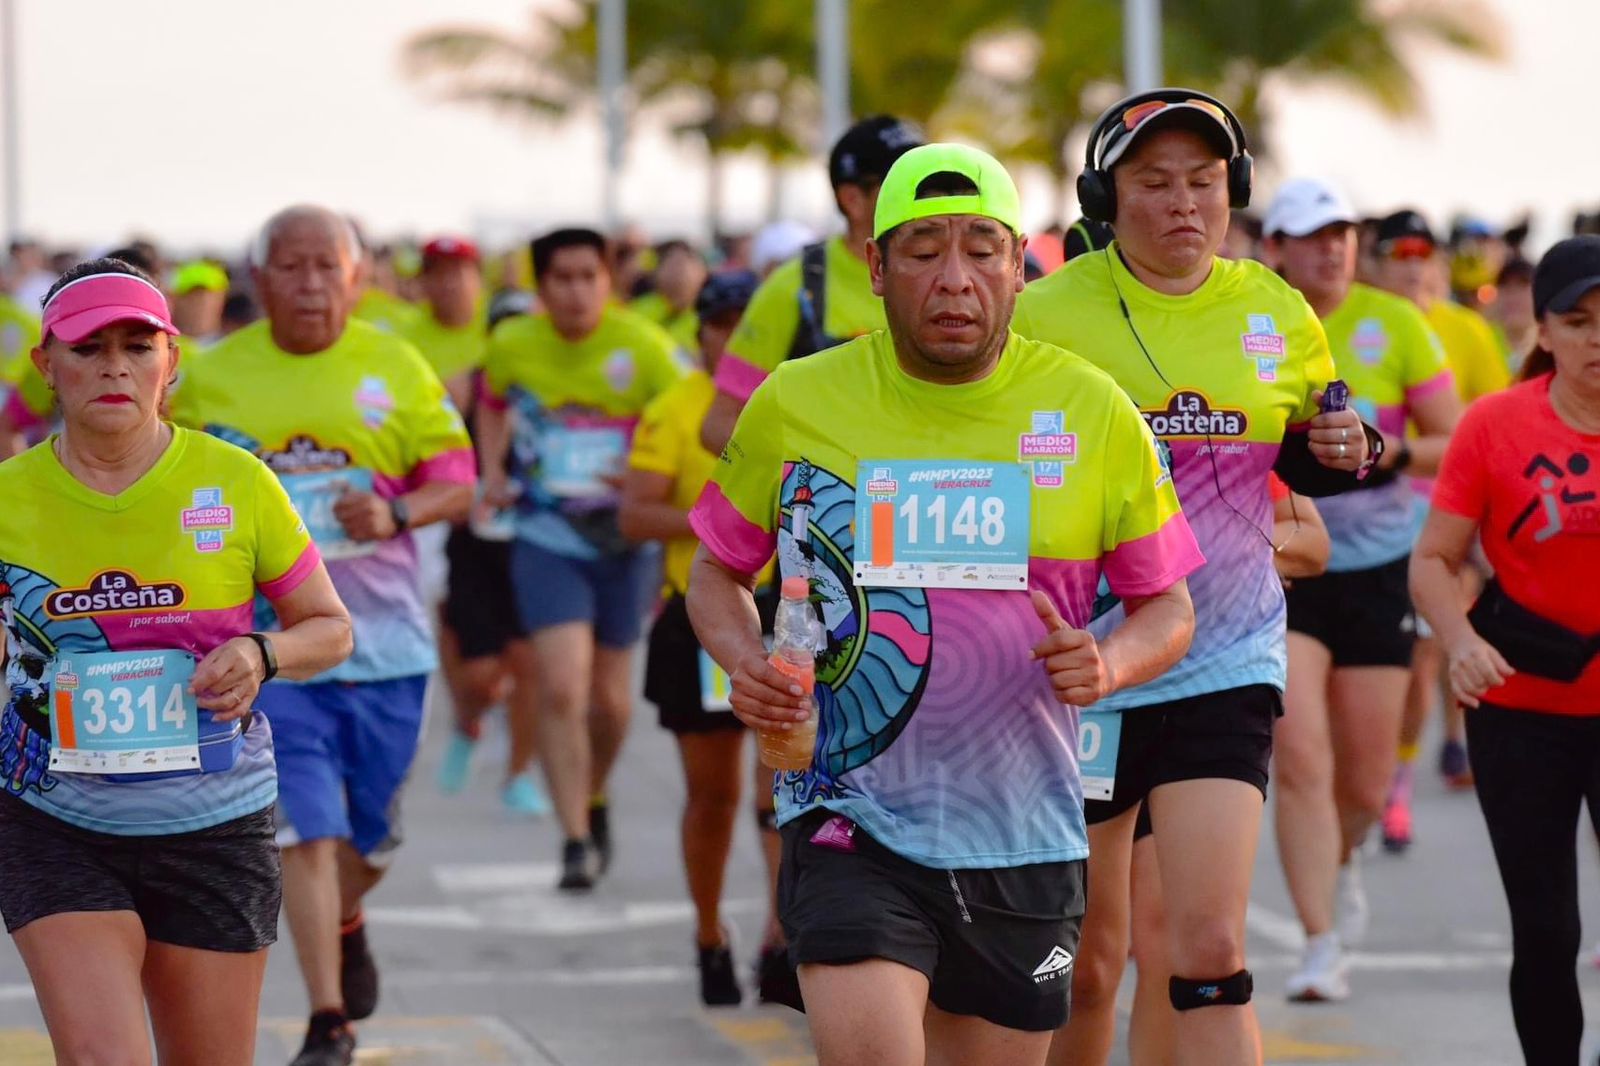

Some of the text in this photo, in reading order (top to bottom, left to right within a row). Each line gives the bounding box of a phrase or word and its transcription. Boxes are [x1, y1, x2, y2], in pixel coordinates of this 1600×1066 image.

[1245, 336, 1280, 346] MEDIO
[1177, 394, 1200, 412] La
[1145, 411, 1240, 434] osteña
[1023, 436, 1072, 446] MEDIO
[908, 467, 994, 483] #MMPV2023
[933, 479, 993, 490] VERACRUZ
[185, 508, 228, 519] MEDIO
[900, 494, 1005, 546] 1148
[101, 574, 127, 590] La
[54, 586, 175, 613] Costeña
[86, 656, 165, 677] #MMPV2023
[110, 667, 165, 682] VERACRUZ
[82, 683, 187, 735] 3314
[1034, 972, 1056, 984] NIKE
